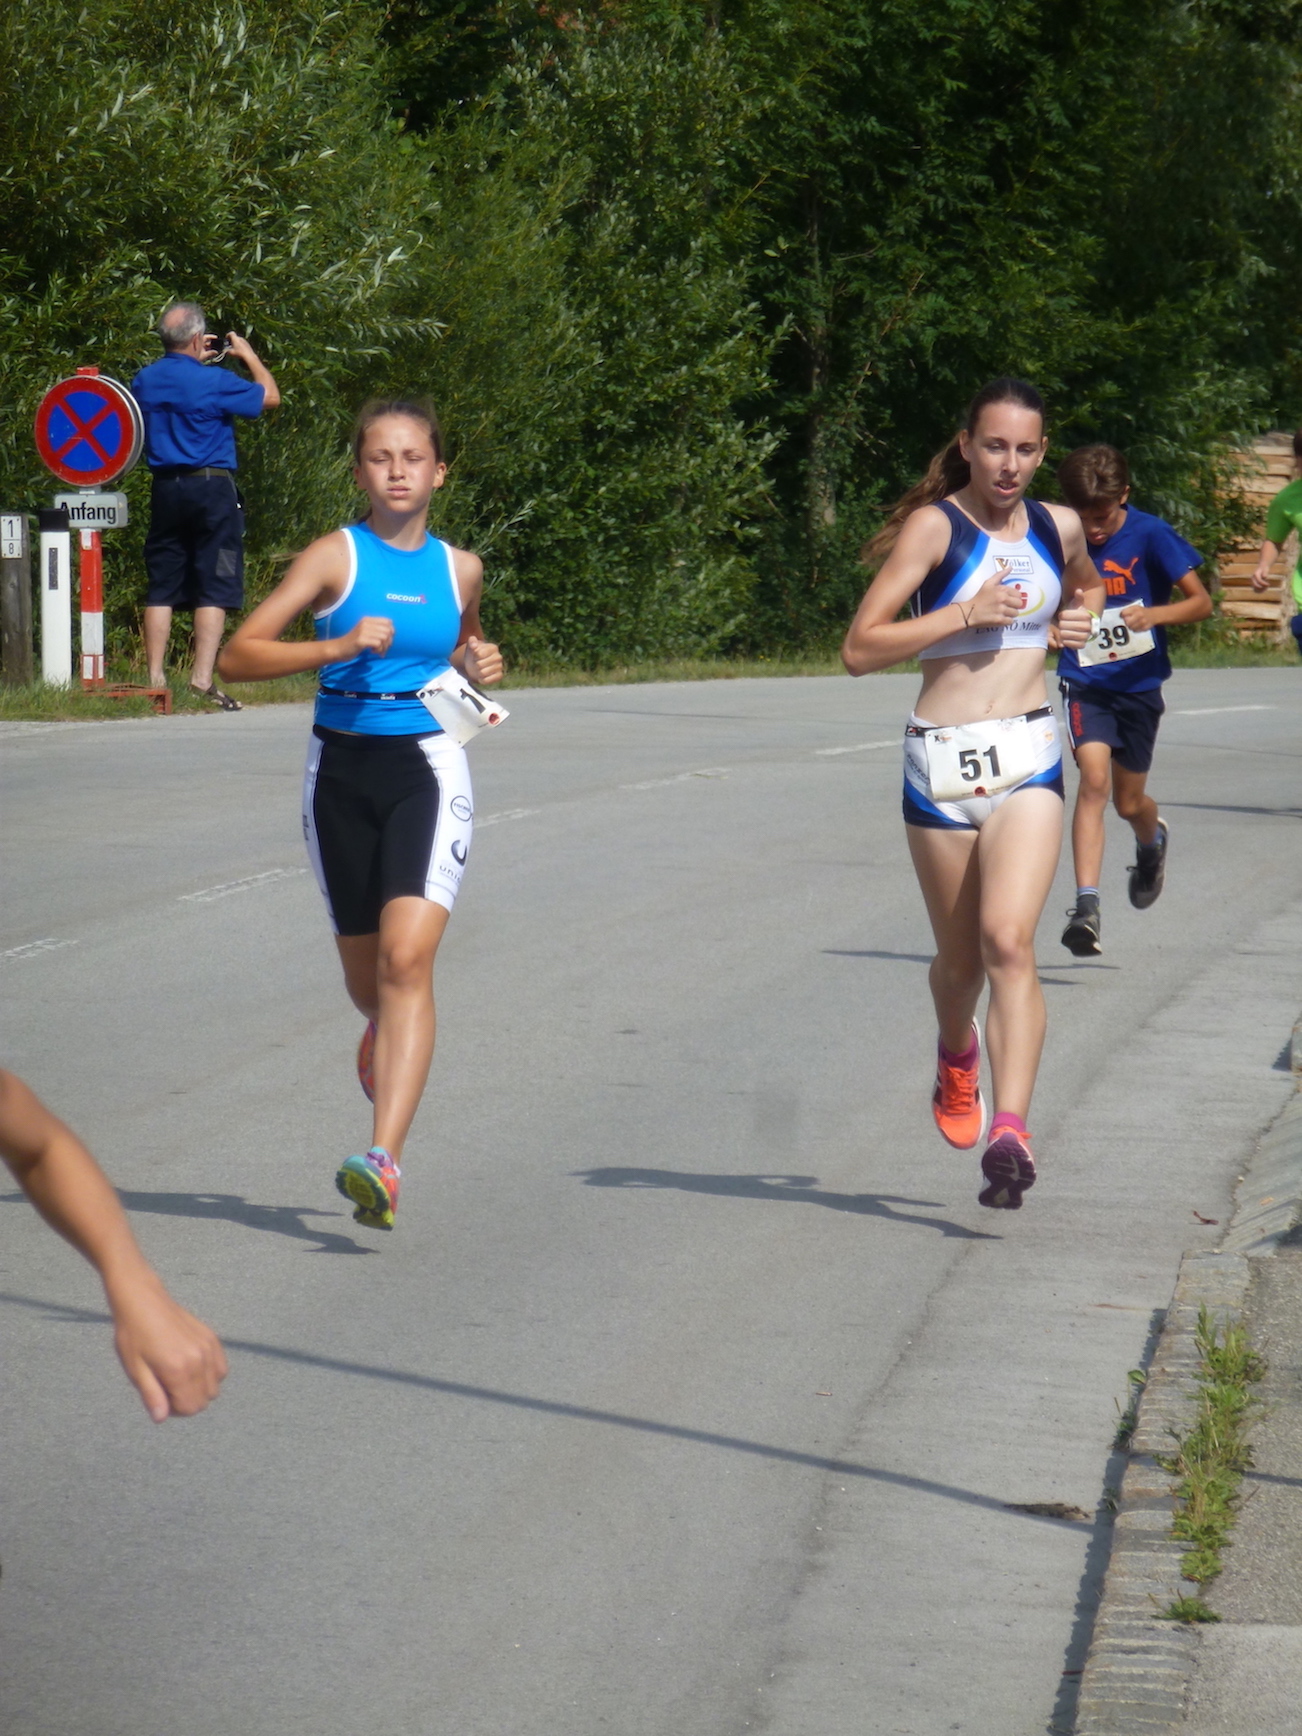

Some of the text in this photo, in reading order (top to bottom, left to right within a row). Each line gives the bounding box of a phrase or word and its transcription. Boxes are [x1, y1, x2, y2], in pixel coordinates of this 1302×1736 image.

[8, 520, 14, 538] 1
[9, 543, 15, 555] 8
[1098, 625, 1131, 650] 39
[958, 745, 1002, 782] 51
